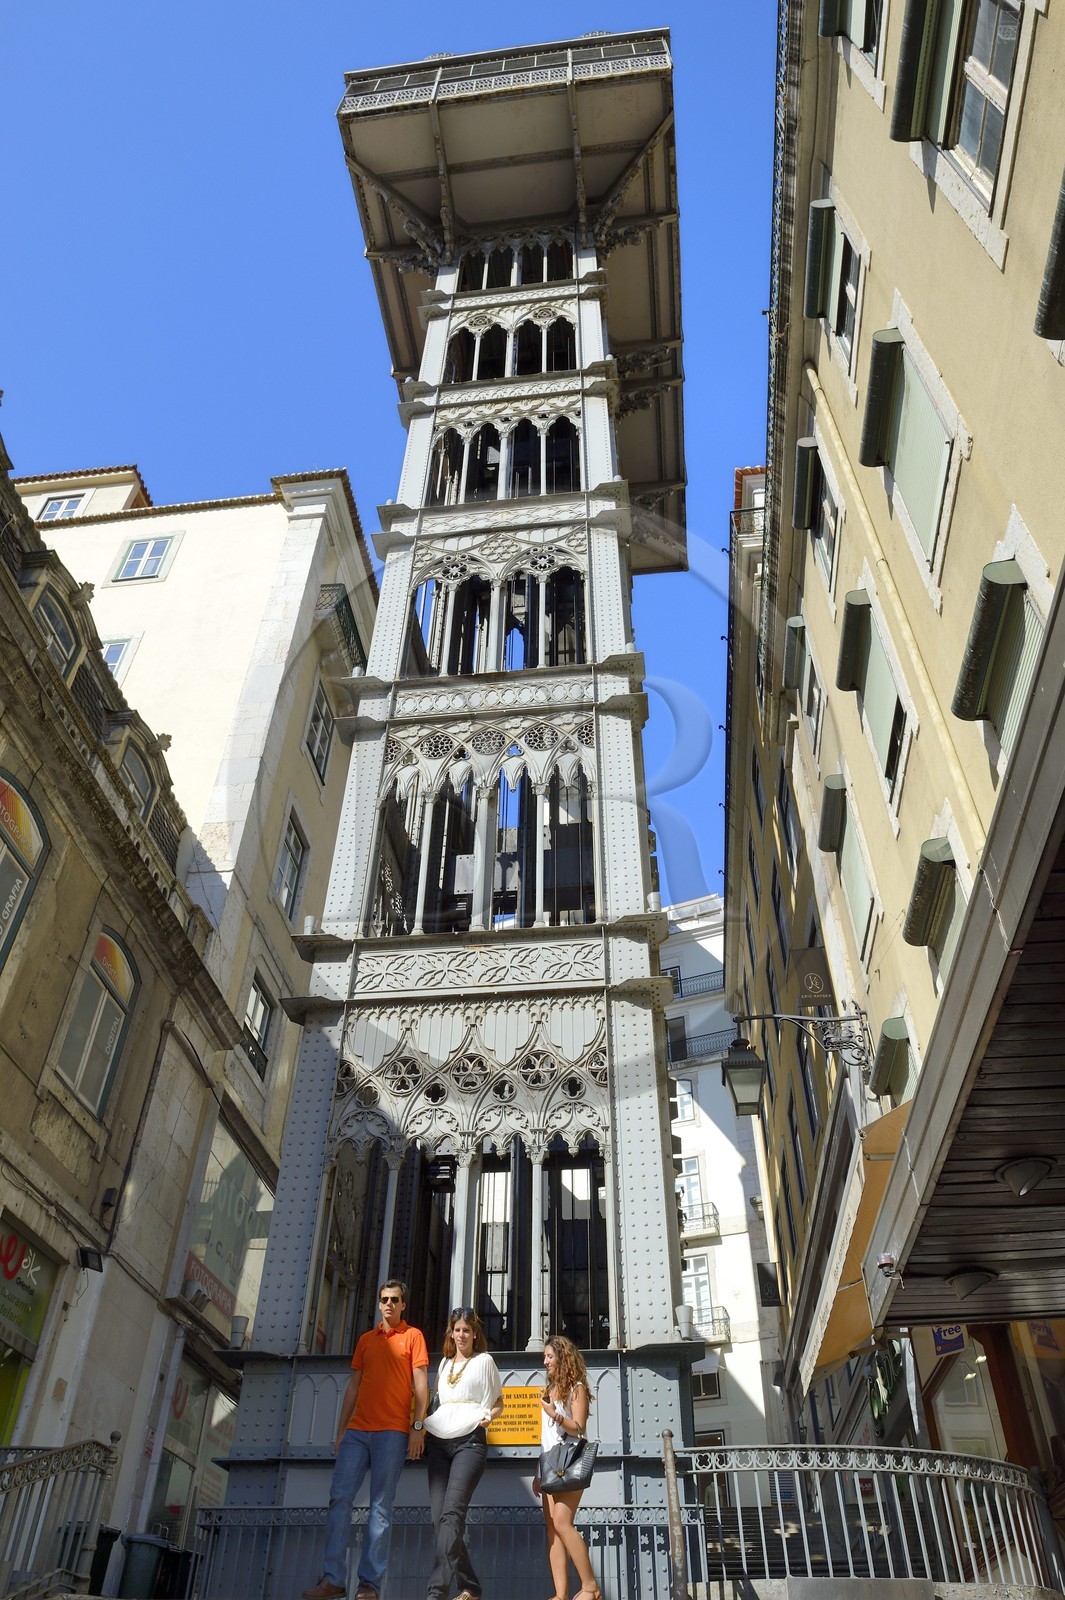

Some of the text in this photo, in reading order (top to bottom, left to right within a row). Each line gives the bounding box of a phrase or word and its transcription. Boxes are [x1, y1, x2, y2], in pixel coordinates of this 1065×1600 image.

[2, 878, 23, 919] GRAFIA
[105, 1017, 121, 1055] DIGITAL
[189, 1260, 233, 1314] FOTOGRAFIA
[936, 1325, 962, 1337] free
